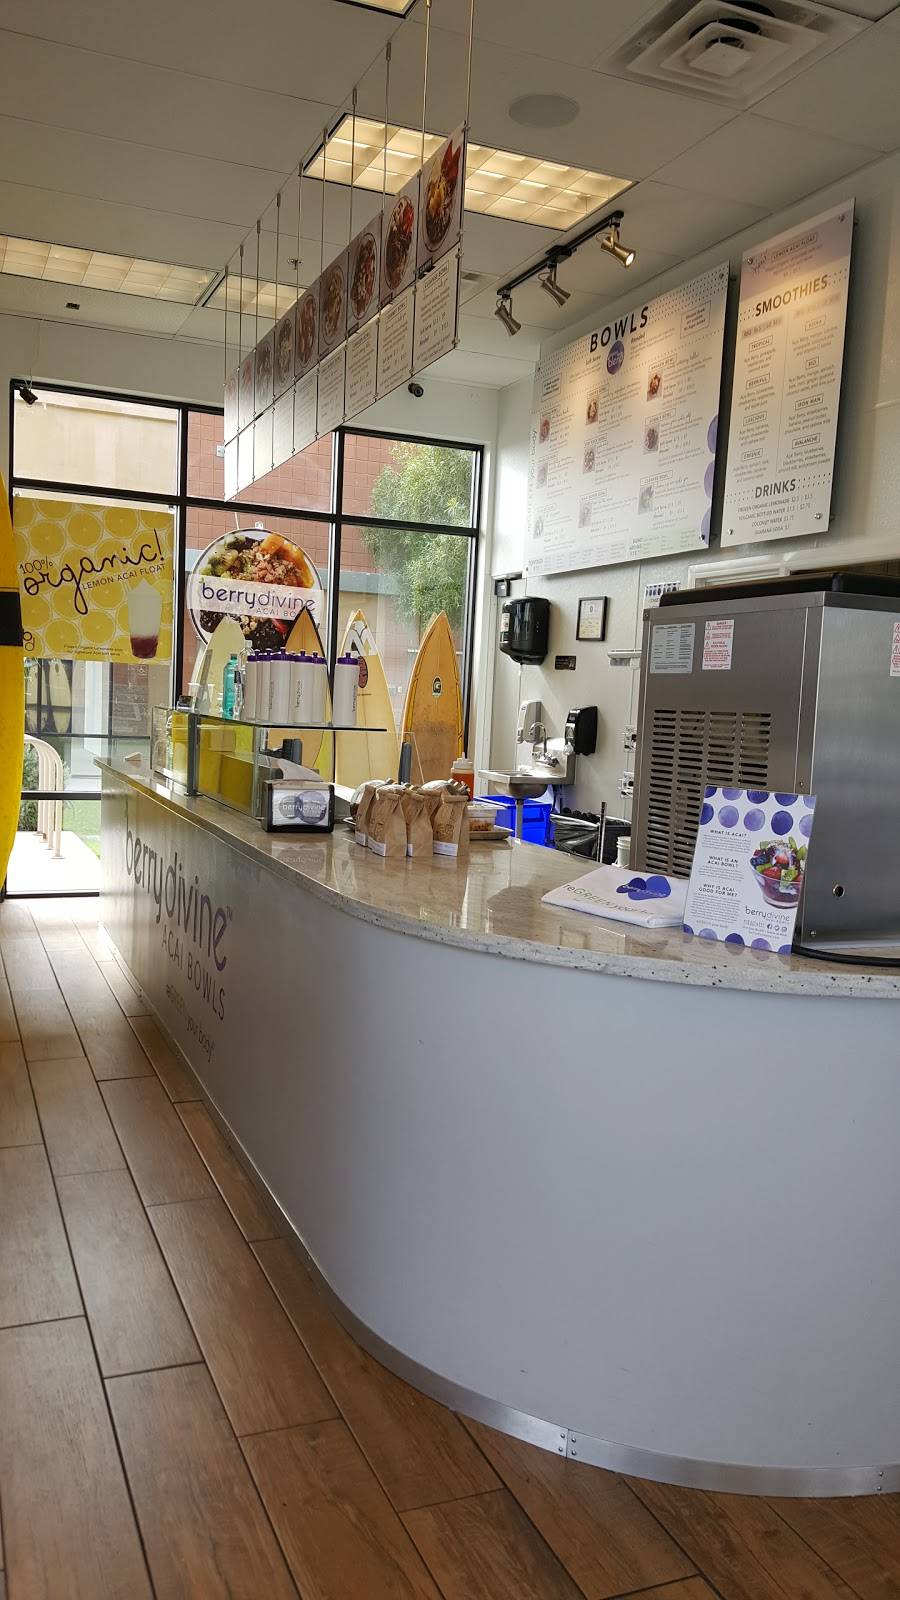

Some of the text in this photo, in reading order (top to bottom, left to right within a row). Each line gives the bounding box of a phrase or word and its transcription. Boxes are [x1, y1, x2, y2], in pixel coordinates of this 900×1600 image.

[756, 274, 828, 316] SMOOTHIES
[590, 306, 648, 353] BOWLS
[755, 479, 796, 498] DRINKS
[20, 556, 54, 574] 100%
[24, 528, 164, 615] organic!
[82, 563, 166, 590] LEMON ACAI FLOAT
[202, 582, 316, 612] berrydivine
[256, 608, 278, 616] ACAI
[126, 797, 227, 971] berrydivine
[745, 905, 790, 922] berrydivine
[162, 924, 184, 970] ACAI
[187, 952, 225, 1021] BOWLS
